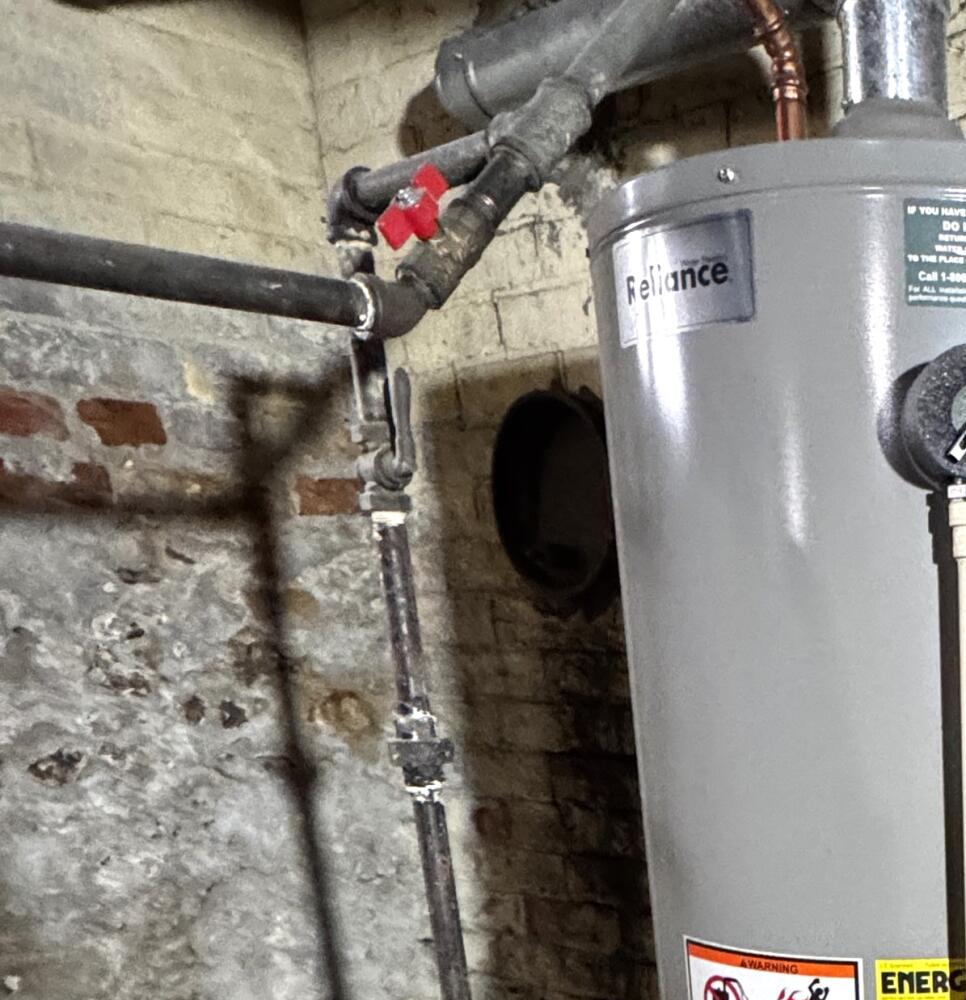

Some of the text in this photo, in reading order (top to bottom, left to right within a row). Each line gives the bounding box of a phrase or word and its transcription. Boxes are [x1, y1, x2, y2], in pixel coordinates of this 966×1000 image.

[908, 206, 916, 214] IF
[920, 206, 939, 215] YOU
[941, 207, 966, 217] HAVE
[942, 221, 959, 231] DO
[918, 271, 938, 281] Call
[626, 262, 730, 305] Reliance
[748, 960, 799, 974] WARNING
